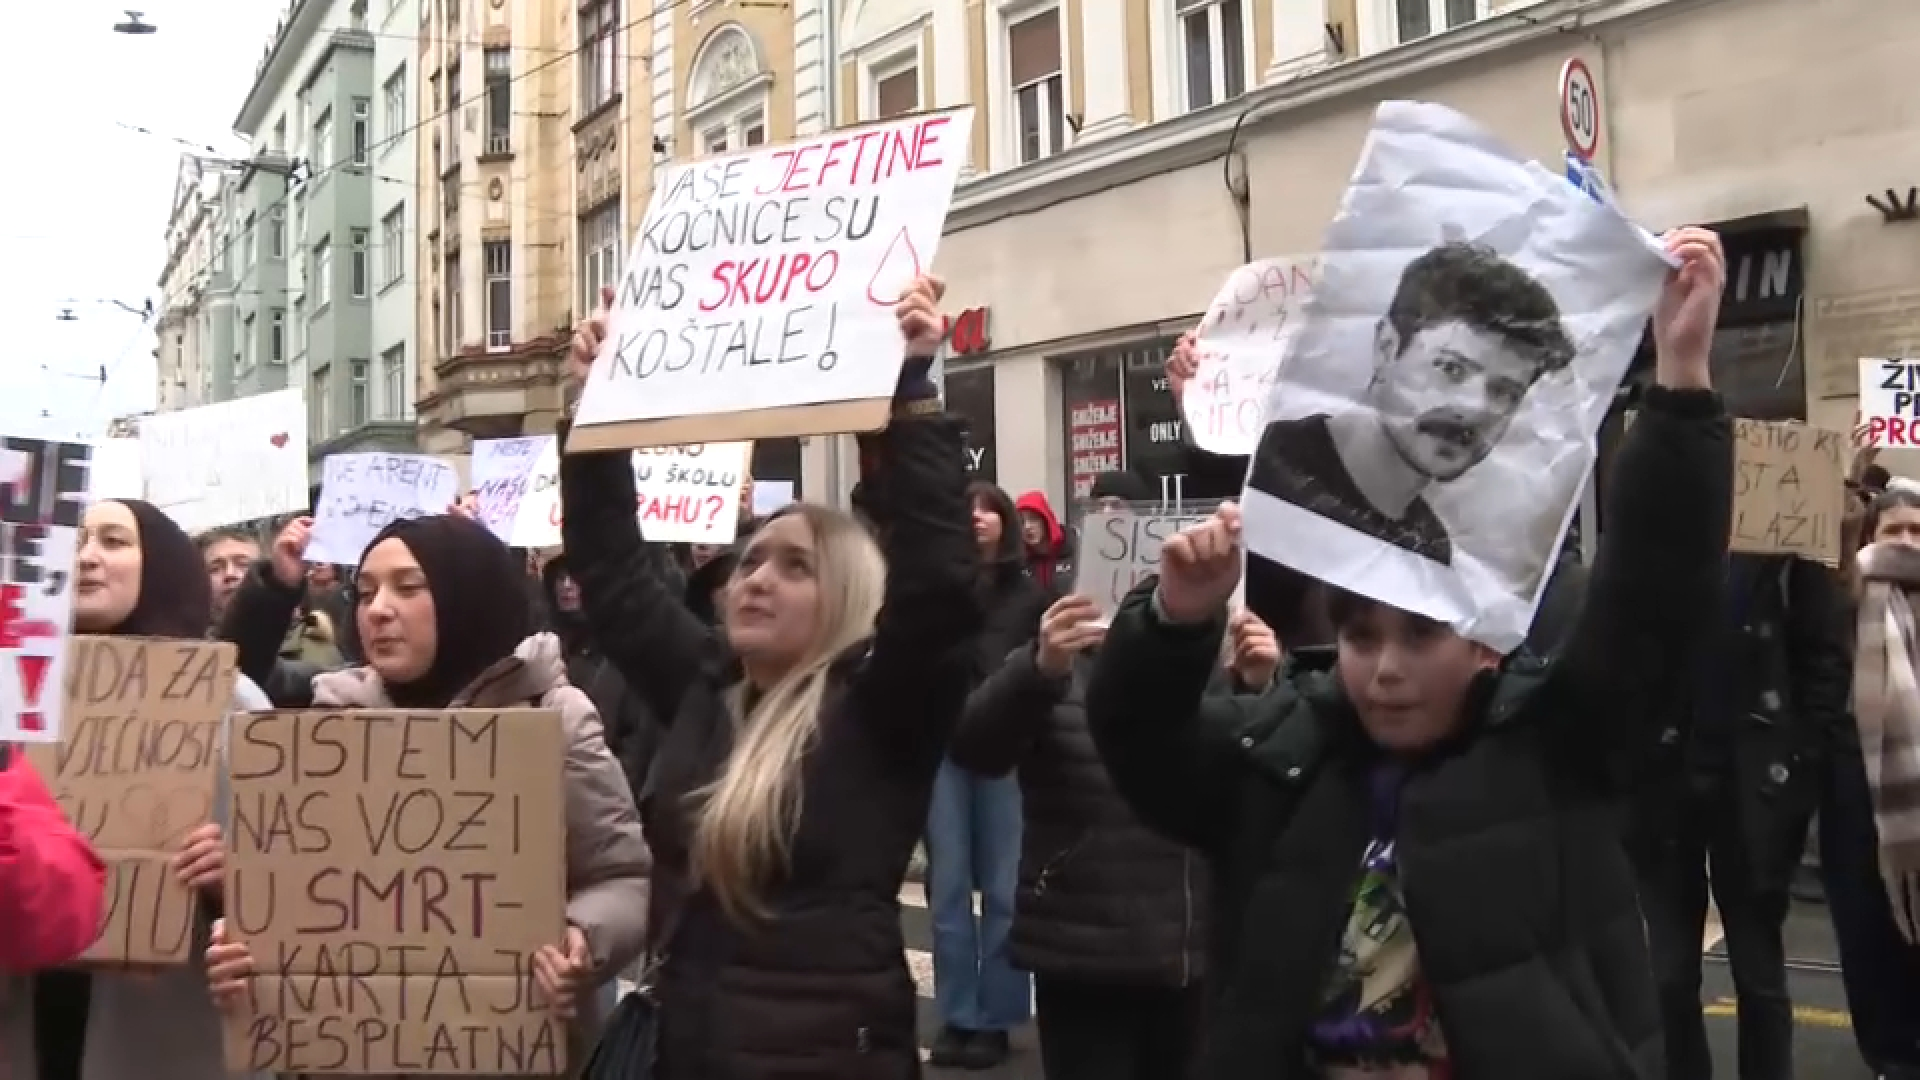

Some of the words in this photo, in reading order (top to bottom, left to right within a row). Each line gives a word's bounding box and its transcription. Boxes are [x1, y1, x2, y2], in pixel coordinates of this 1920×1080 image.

[1570, 80, 1592, 136] 50
[662, 158, 749, 207] VAŠE
[754, 116, 952, 195] JEFTINE
[642, 197, 809, 254] KOČNICE
[814, 195, 880, 242] SU
[620, 264, 689, 310] NAS
[698, 250, 839, 311] SKUPO
[1150, 421, 1182, 442] ONLY
[637, 465, 653, 482] U
[665, 463, 736, 488] ŠKOLU
[231, 713, 498, 783] SISTEM
[231, 790, 332, 855] NAS
[357, 788, 522, 855] VOZI
[235, 870, 275, 936] U
[298, 866, 524, 938] SMRT-
[279, 941, 472, 1022] KARTA
[247, 1016, 557, 1071] BESPLATNA
